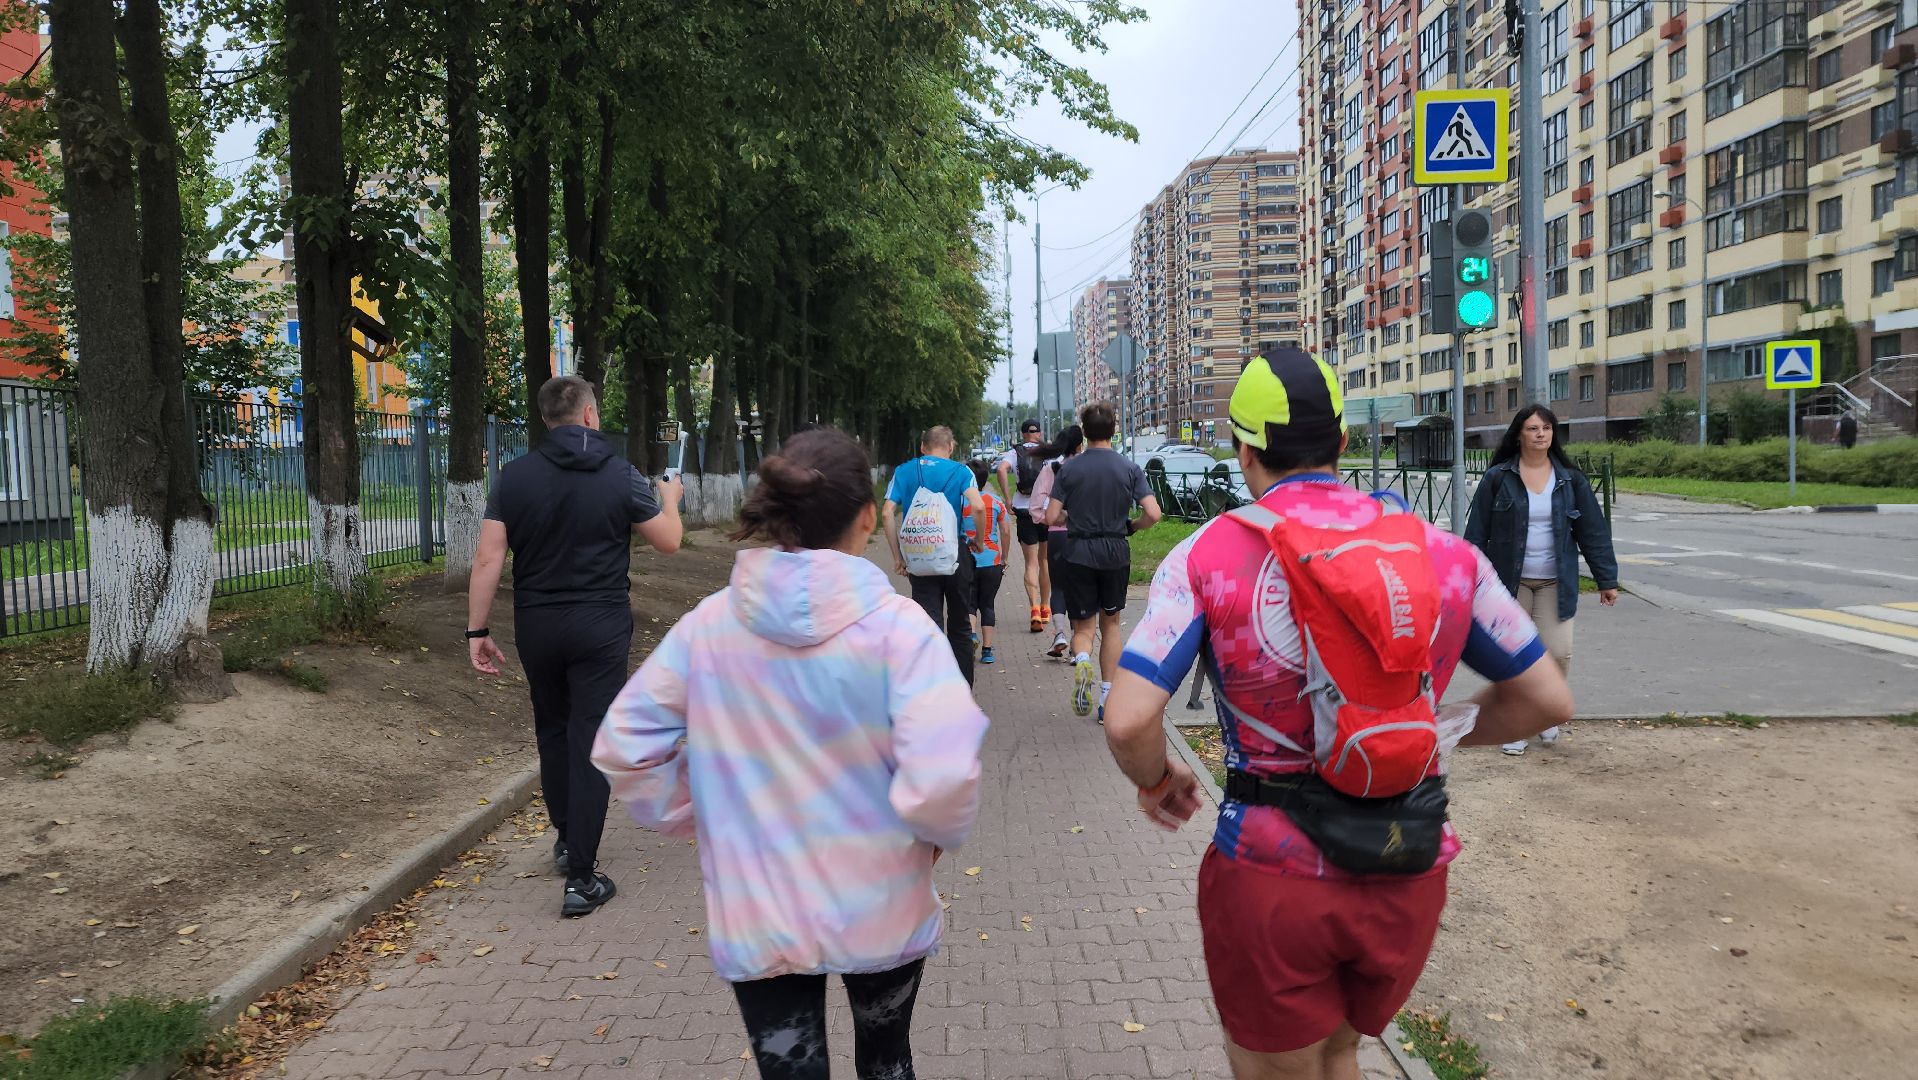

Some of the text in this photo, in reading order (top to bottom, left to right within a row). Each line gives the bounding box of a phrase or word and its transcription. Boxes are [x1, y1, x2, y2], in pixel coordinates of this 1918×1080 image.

[1462, 257, 1489, 282] 24
[900, 534, 945, 545] MARATHON
[1376, 557, 1416, 640] CAMELBAK
